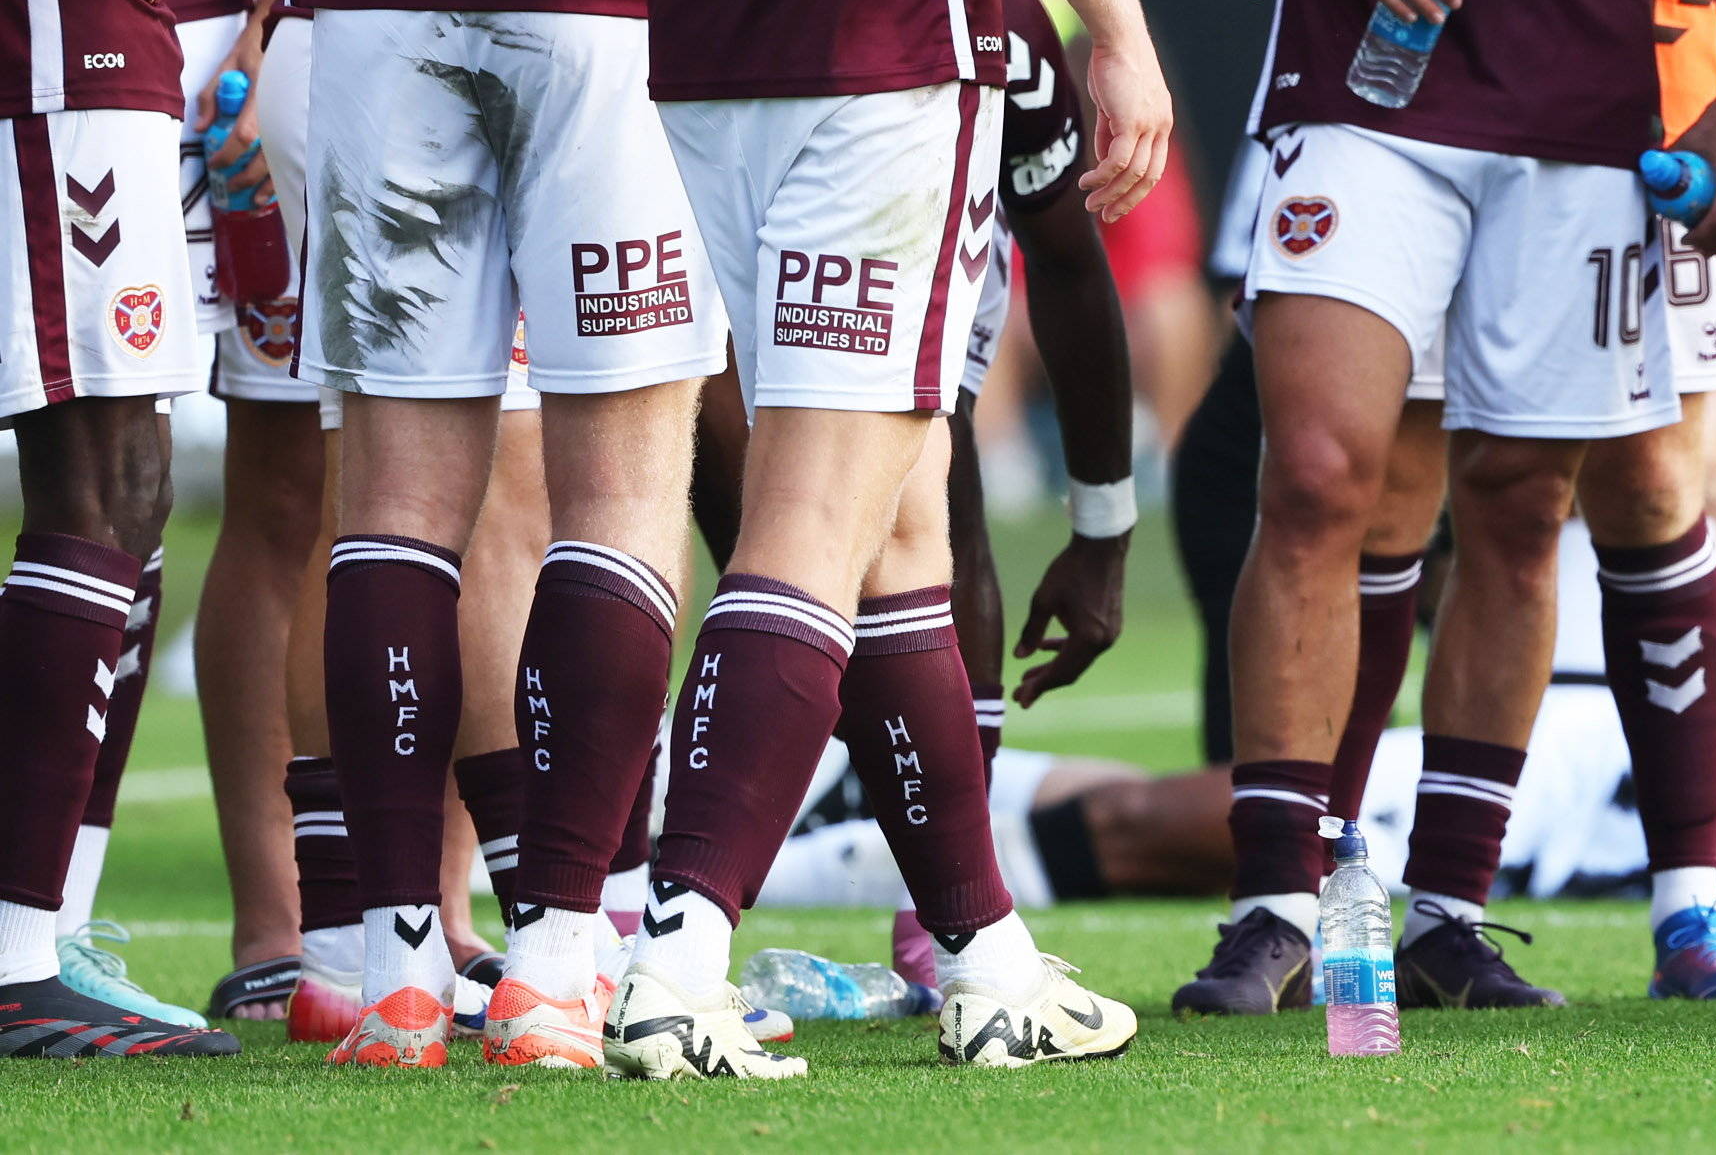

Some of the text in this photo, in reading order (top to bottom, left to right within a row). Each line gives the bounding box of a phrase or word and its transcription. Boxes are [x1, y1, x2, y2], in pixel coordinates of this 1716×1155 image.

[571, 230, 688, 293] PPE
[776, 249, 899, 312] PPE
[580, 286, 687, 314] INDUSTRIAL
[581, 306, 689, 333] SUPPLIES LTD
[777, 306, 888, 333] INDUSTRIAL
[776, 327, 886, 352] SUPPLIES LTD
[388, 646, 420, 757] HMFC
[526, 666, 552, 772] HMFC
[688, 652, 723, 771] HMFC
[884, 714, 929, 826] HMFC
